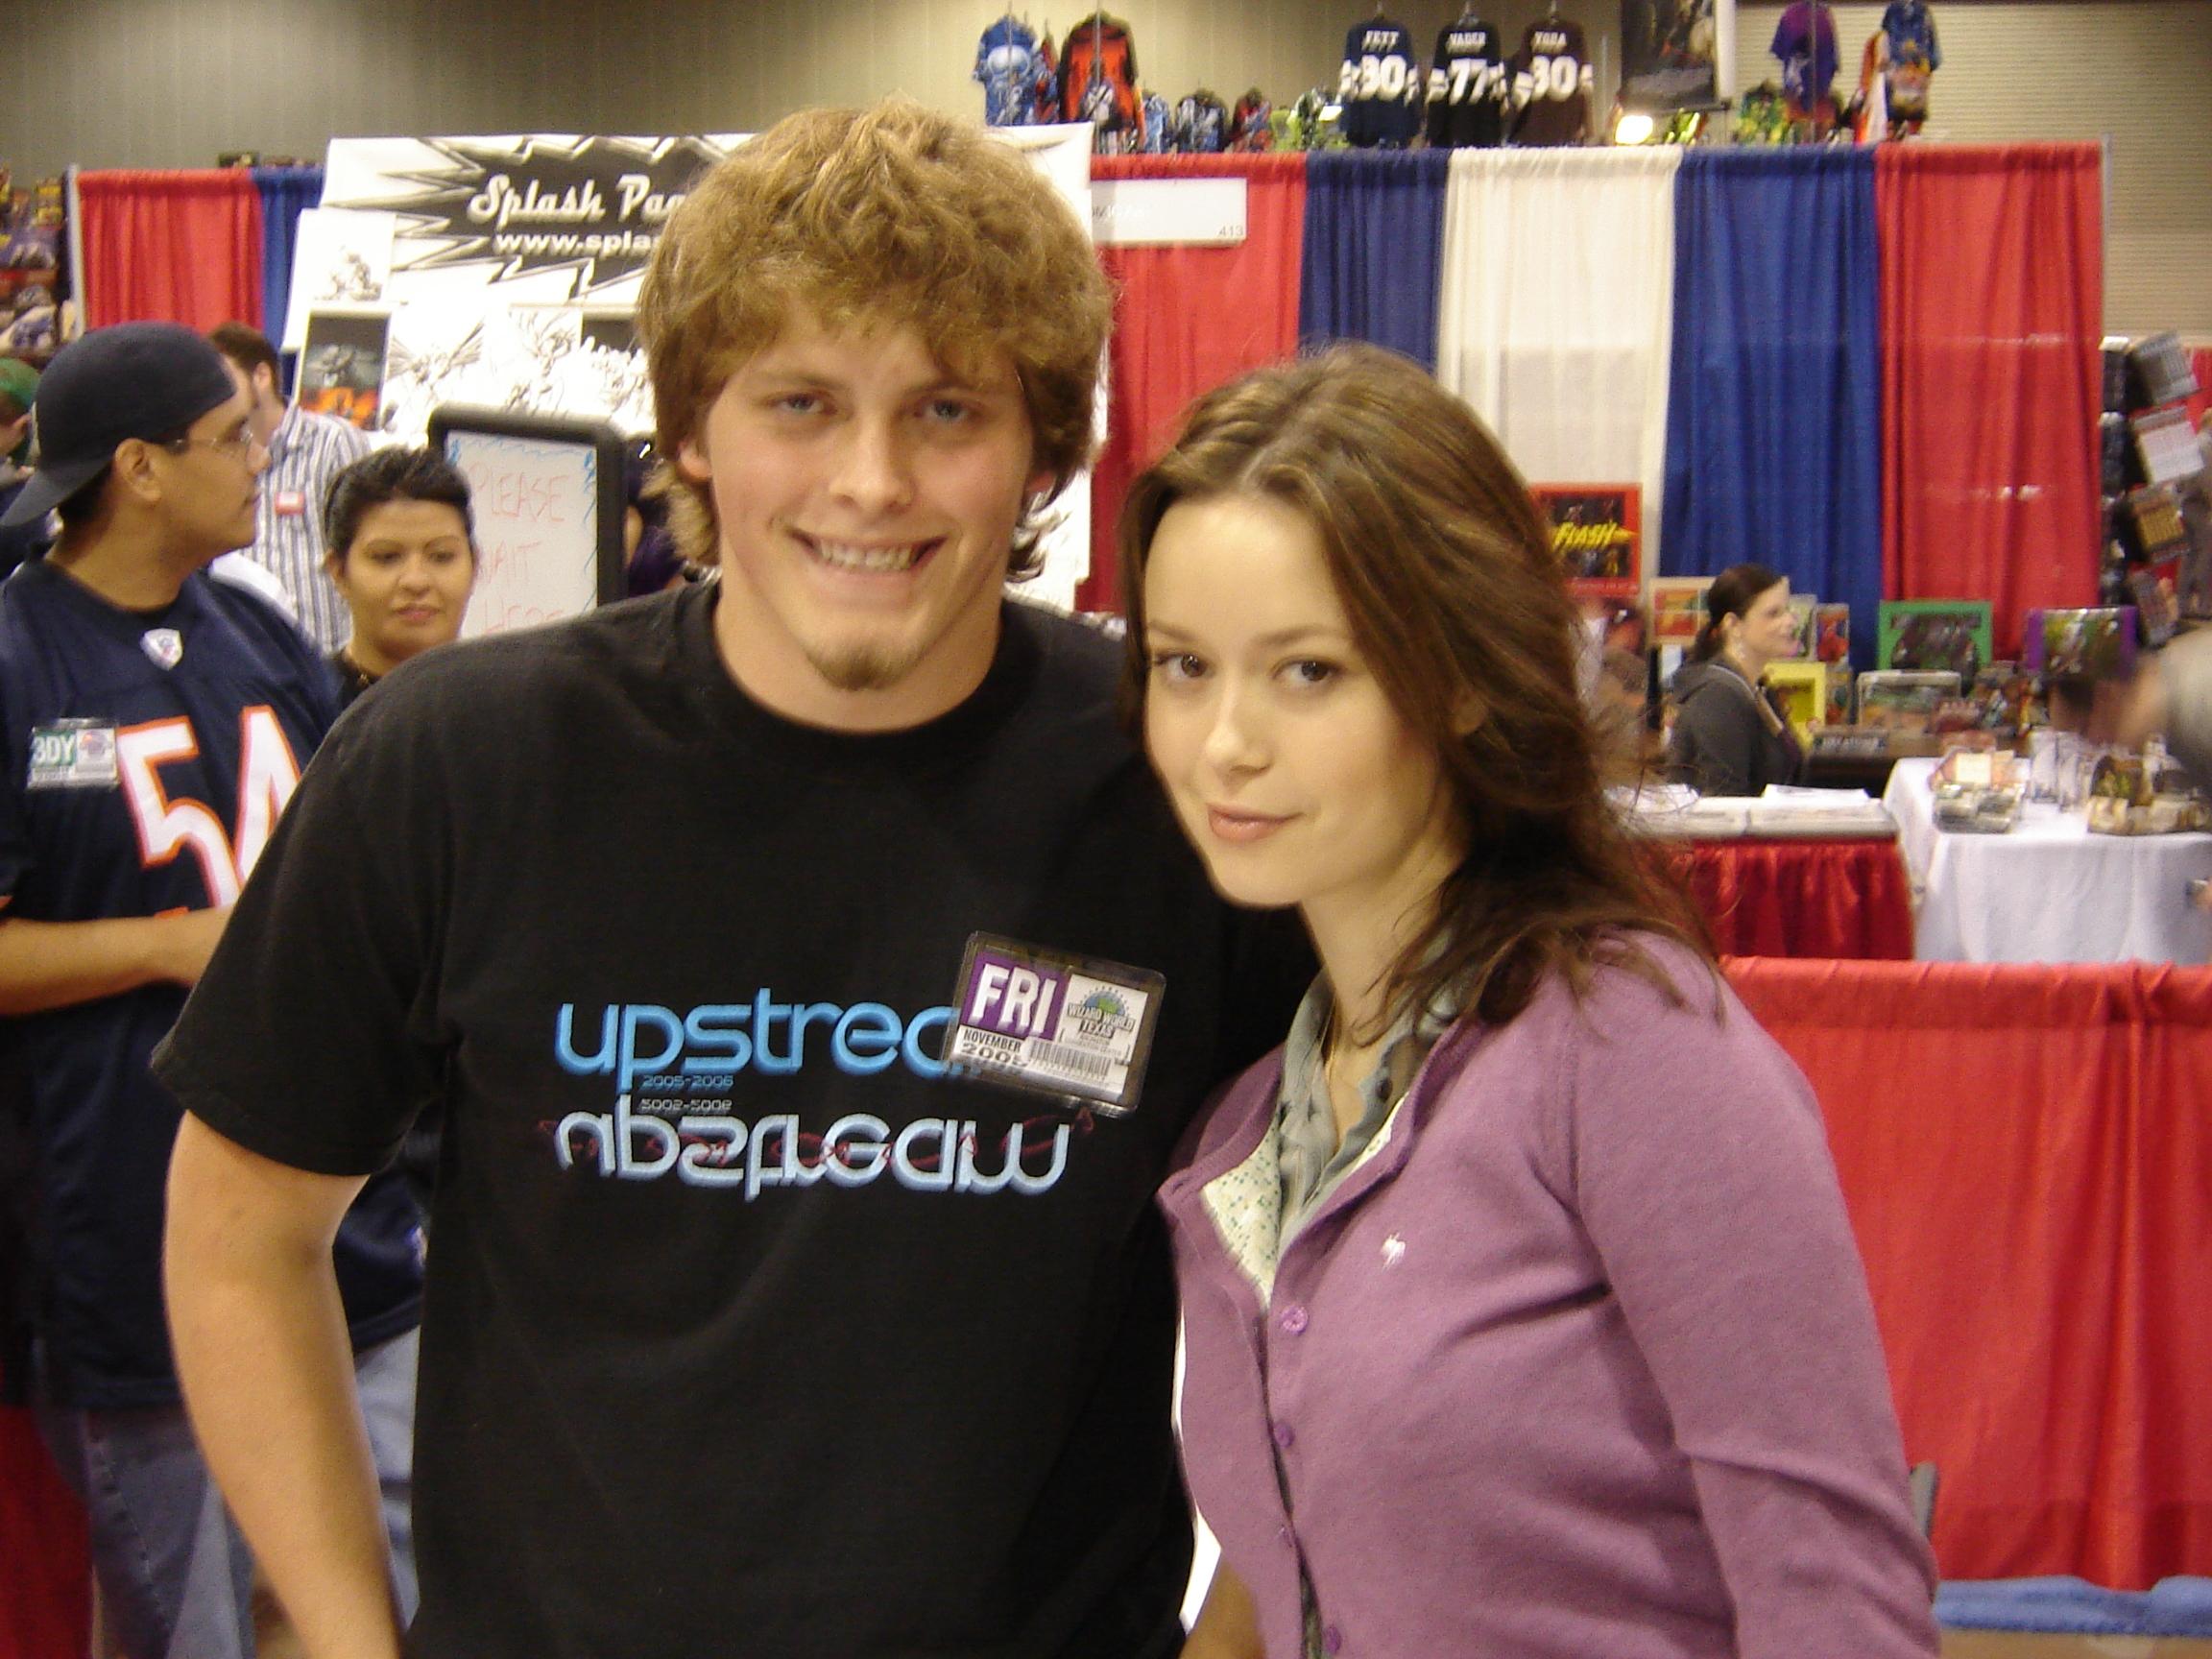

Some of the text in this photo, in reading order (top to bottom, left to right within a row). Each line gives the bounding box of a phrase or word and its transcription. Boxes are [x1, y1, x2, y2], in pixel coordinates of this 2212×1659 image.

[1449, 59, 1488, 104] 77
[468, 174, 606, 230] Splash
[1218, 225, 1243, 237] 413
[968, 963, 1056, 1036] FRI
[555, 988, 964, 1094] upstrea
[963, 1028, 1022, 1053] NOVEMBER
[1078, 1019, 1116, 1039] TEXAS
[640, 1075, 734, 1092] 2005-2006
